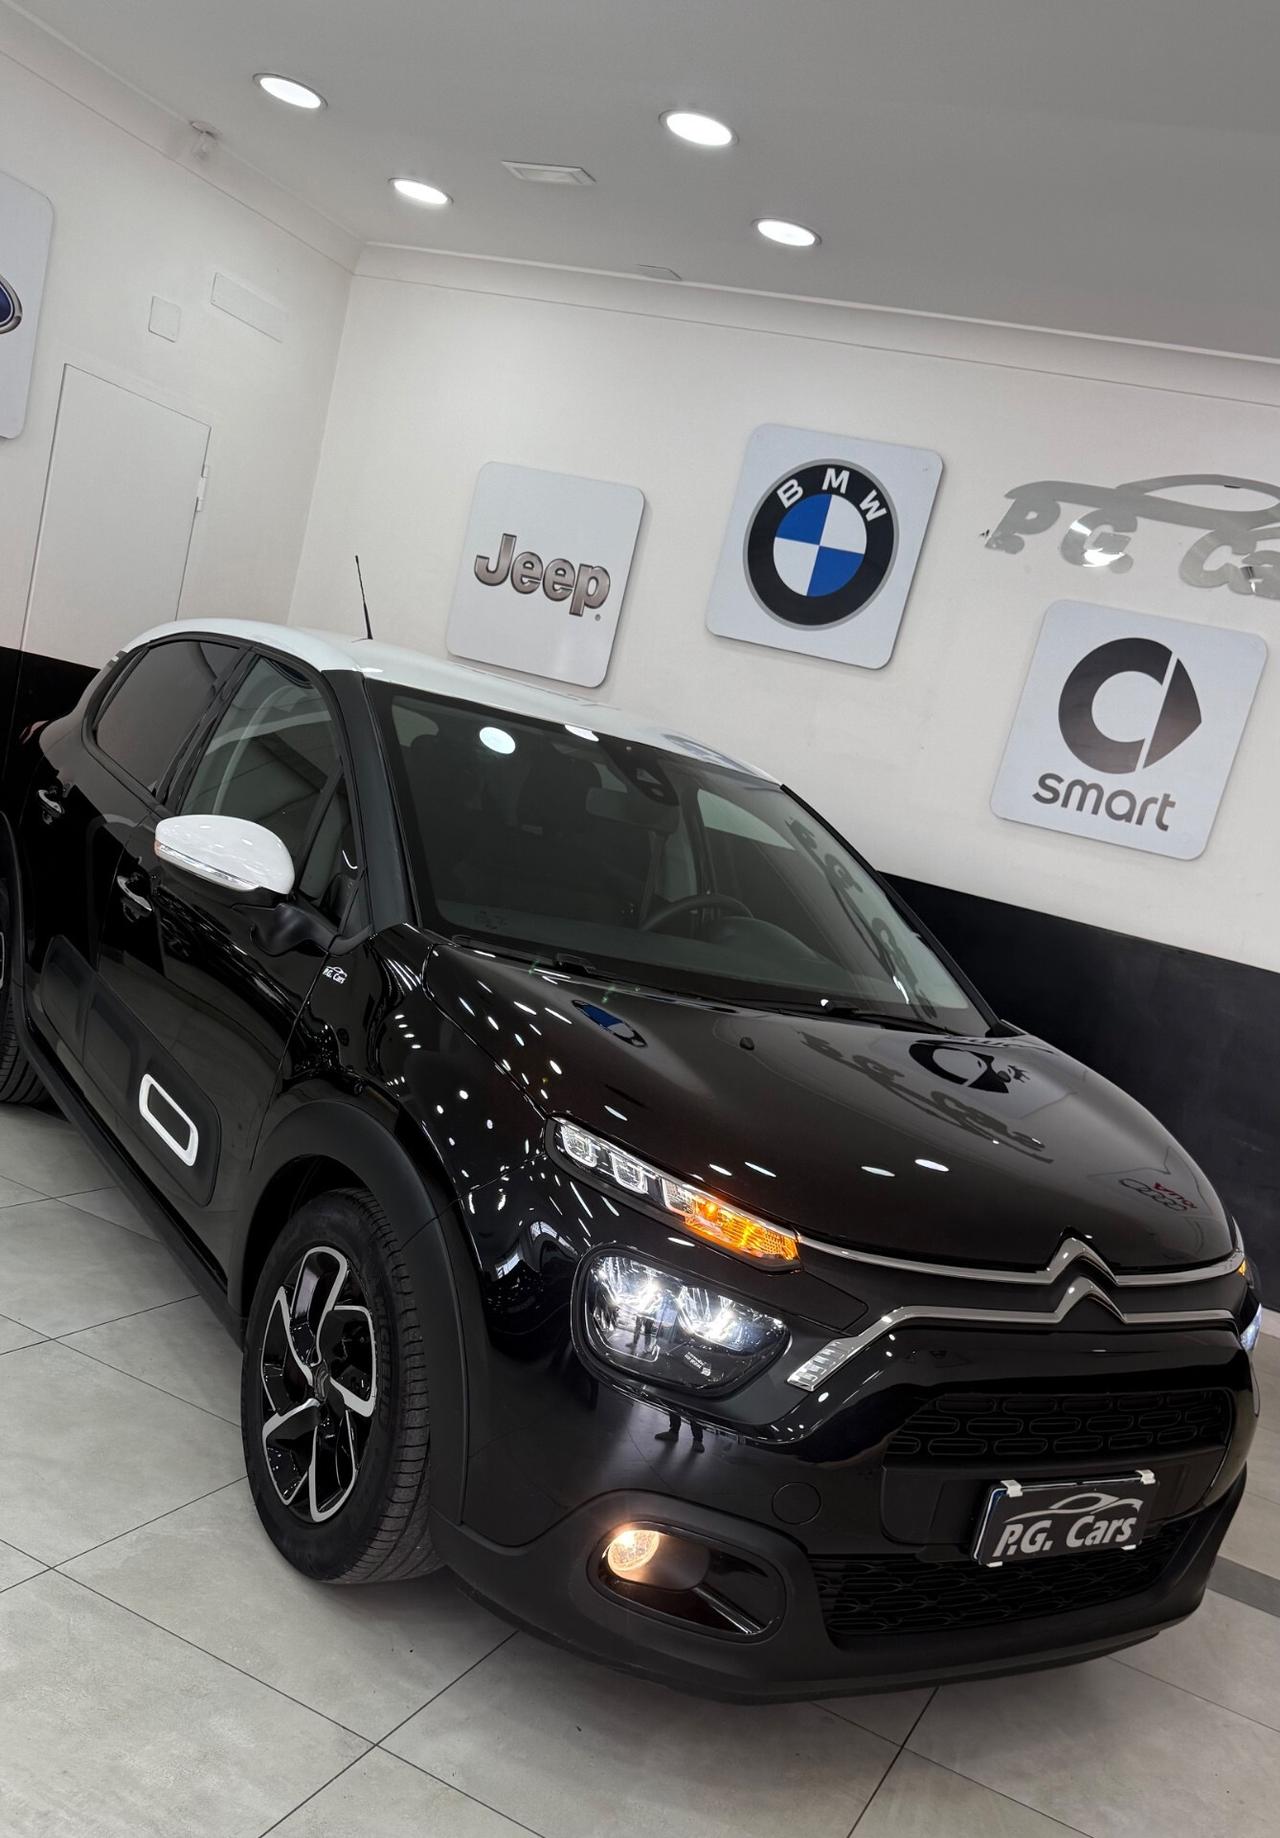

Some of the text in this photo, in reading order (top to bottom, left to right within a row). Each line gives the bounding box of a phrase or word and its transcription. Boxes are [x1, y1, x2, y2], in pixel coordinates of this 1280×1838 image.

[776, 467, 888, 523] BMW
[474, 532, 611, 618] Jeep
[1031, 772, 1177, 832] smart
[992, 1515, 1137, 1558] P.G. Cars
